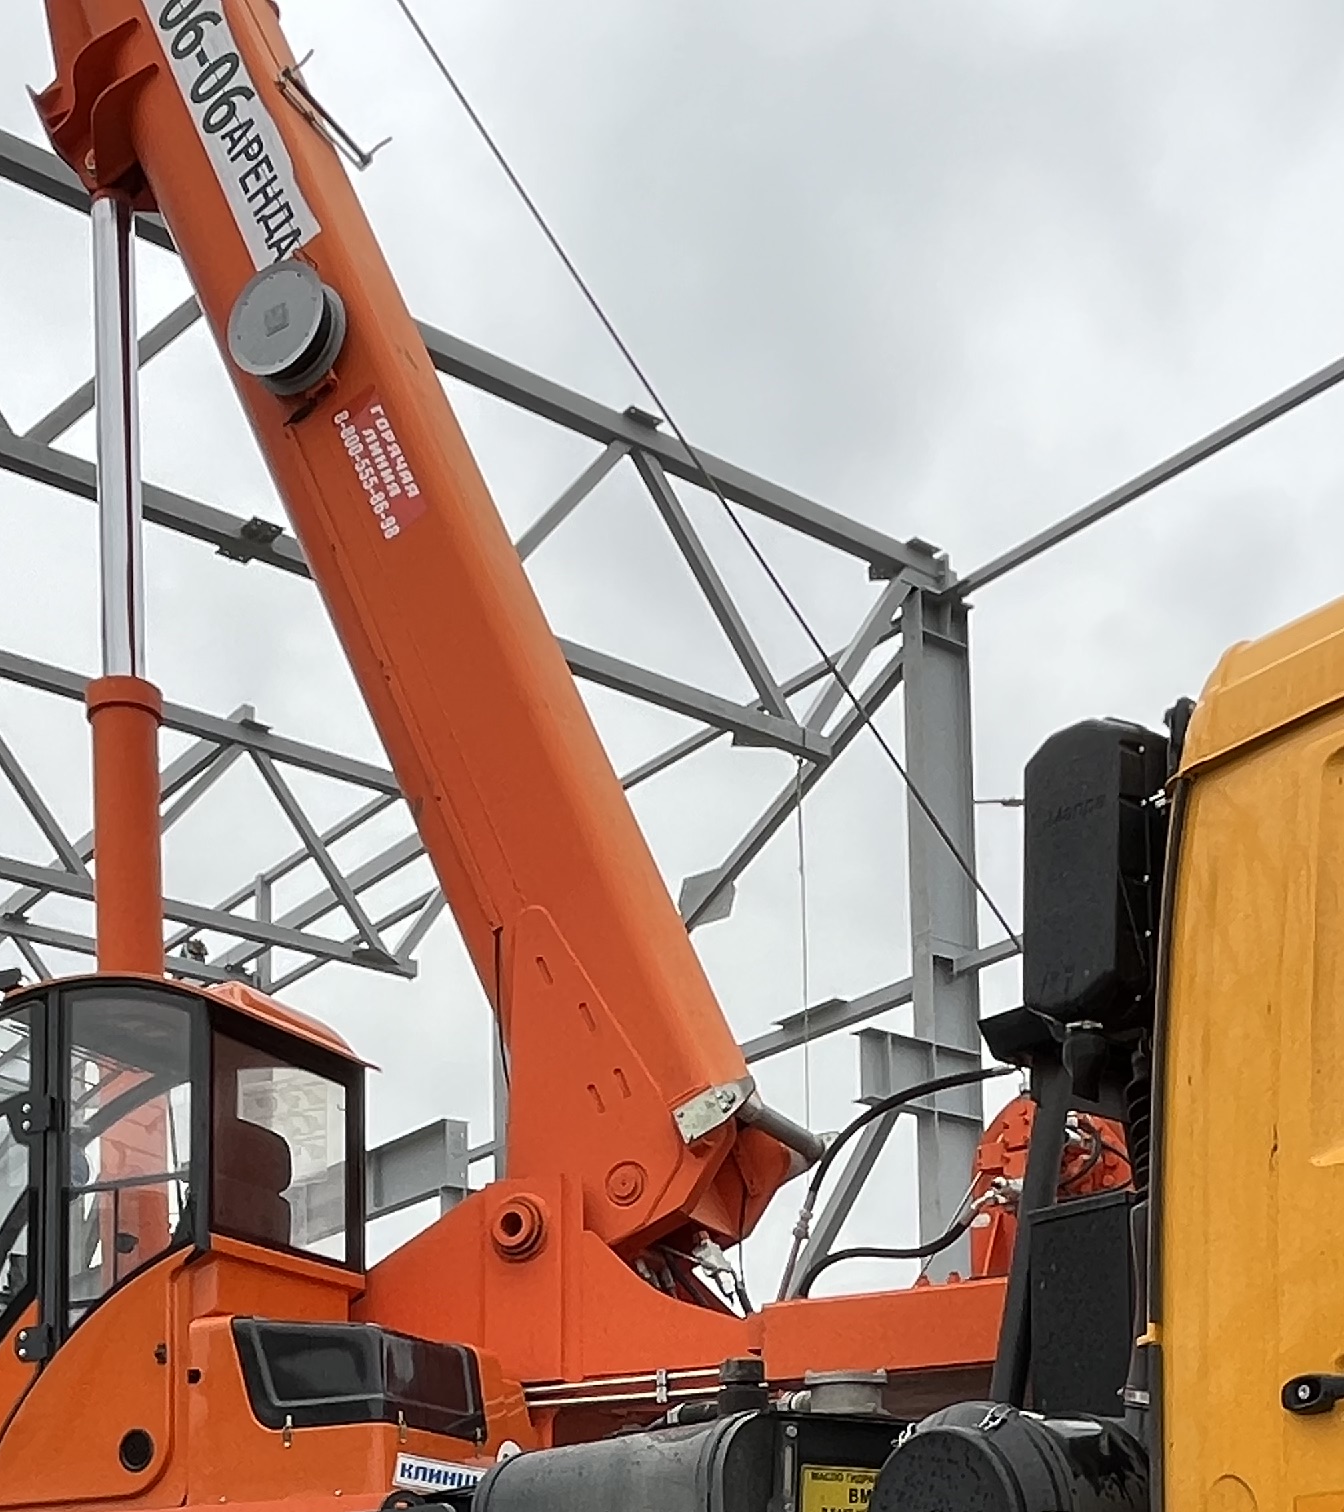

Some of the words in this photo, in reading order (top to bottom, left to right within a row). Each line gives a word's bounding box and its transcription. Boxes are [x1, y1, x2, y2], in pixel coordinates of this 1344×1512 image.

[220, 117, 302, 264] АРЕНДА
[361, 428, 401, 498] ЛИНИЯ
[370, 404, 420, 498] ГОРЯЧАЯ
